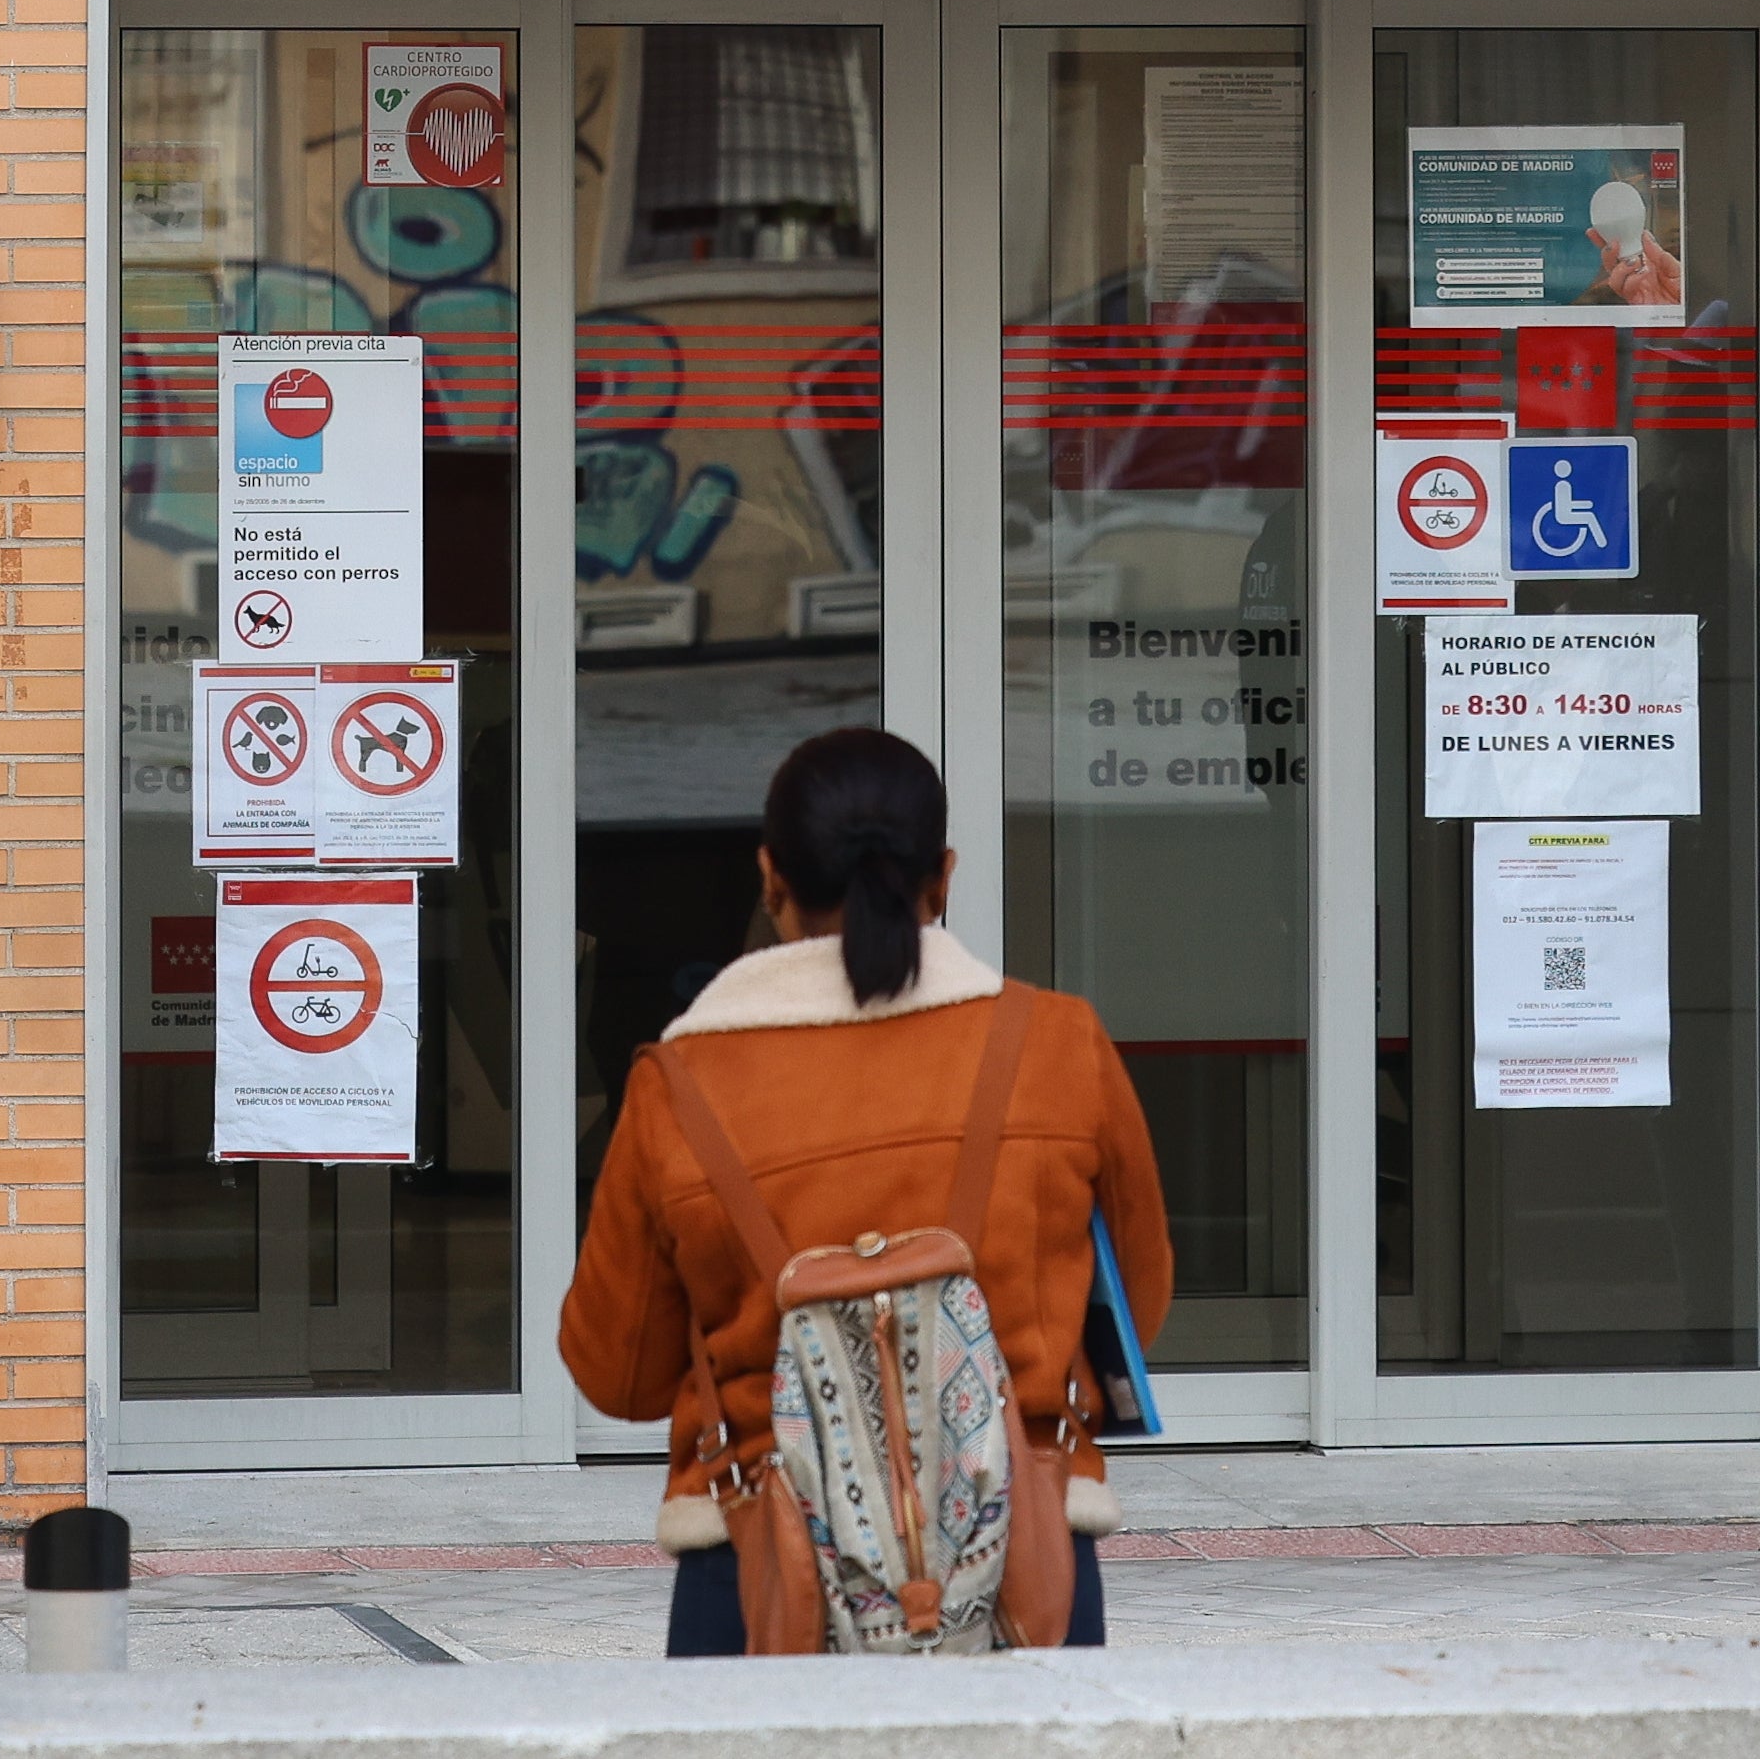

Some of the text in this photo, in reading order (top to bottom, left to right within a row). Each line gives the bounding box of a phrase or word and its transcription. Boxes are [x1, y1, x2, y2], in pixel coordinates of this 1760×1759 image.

[408, 52, 462, 63] CENTRO
[374, 65, 493, 77] CARDIOPROTEGIDO
[1419, 161, 1574, 172] COMUNIDAD DE MADRID
[1420, 213, 1564, 224] COMUNIDAD DE MADRID
[232, 337, 386, 354] Atención previa cita
[238, 454, 298, 473] espacio
[238, 473, 311, 488] sin humo
[234, 527, 302, 542] No está
[234, 546, 340, 564] permitido el
[234, 568, 399, 583] acceso con perros
[1090, 619, 1301, 658] Bienveni
[1442, 633, 1656, 650] HORARIO DE ATENCIÓN
[1442, 659, 1551, 676] AL PÚBLICO
[1089, 698, 1116, 727] a
[1133, 691, 1182, 726] tu
[1442, 693, 1683, 716] DE 8:30 A 14:30 HORAS
[1442, 734, 1675, 752] DE LUNES A VIERNES
[1089, 749, 1148, 787] de
[246, 809, 279, 817] ENTRADA
[280, 809, 297, 817] CON
[271, 819, 310, 828] COMPAÑÍA
[1528, 837, 1605, 845] CITA PREVIA PARA
[152, 1000, 216, 1011] Comunid
[152, 1014, 216, 1027] de Madr
[234, 1086, 288, 1096] PROHIBICIÓN
[290, 1087, 302, 1095] DE
[304, 1087, 338, 1095] ACCESO
[340, 1087, 347, 1095] A
[348, 1087, 380, 1096] CICLOS
[381, 1088, 387, 1096] Y
[236, 1097, 284, 1106] VEHÍCULOS
[346, 1099, 393, 1107] PERSONAL
